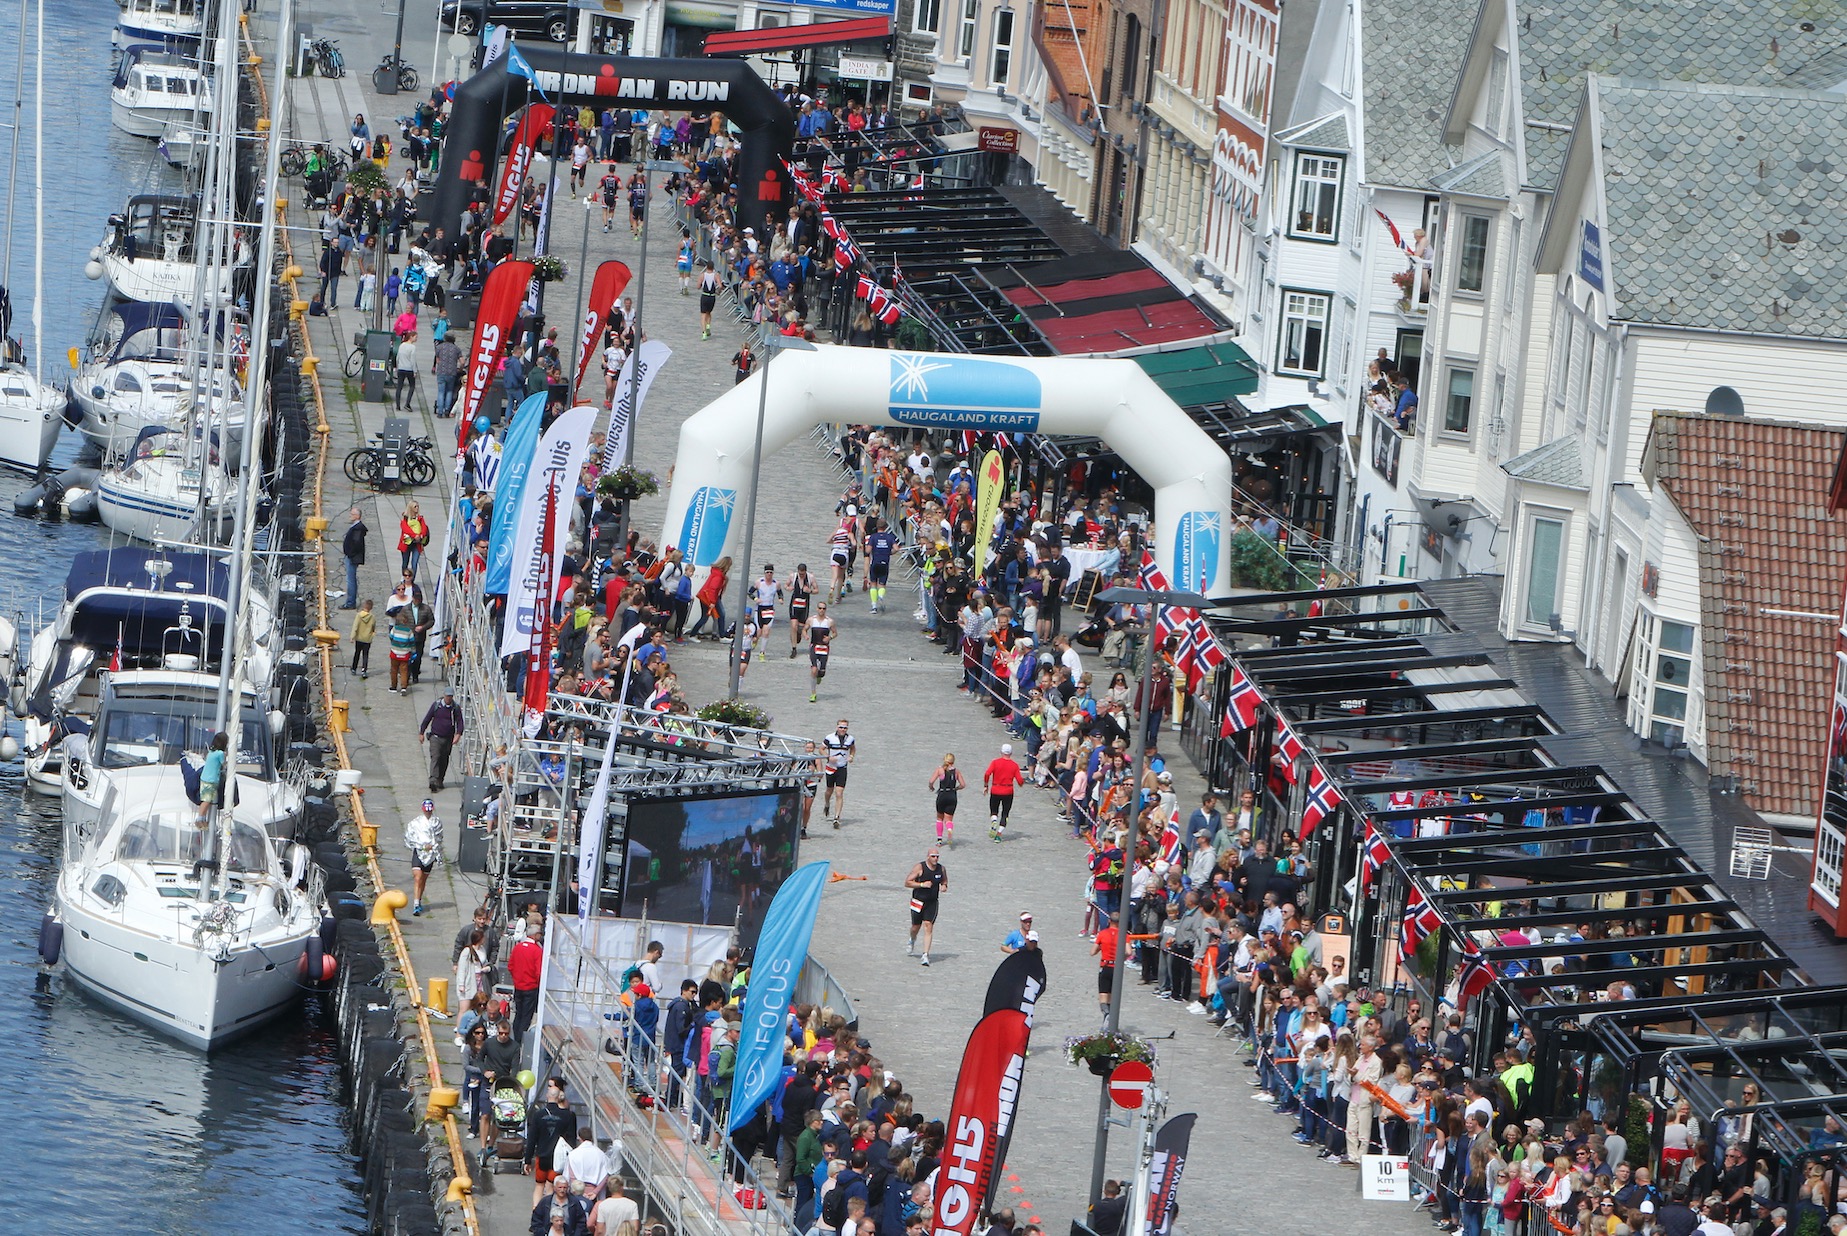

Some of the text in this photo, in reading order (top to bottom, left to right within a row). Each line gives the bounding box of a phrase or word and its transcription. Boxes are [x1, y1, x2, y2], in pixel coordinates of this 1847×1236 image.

[856, 0, 890, 10] redskaper
[533, 64, 729, 101] IRONMAN RUN
[848, 61, 870, 69] INDIA
[848, 67, 869, 75] GATE
[466, 322, 500, 421] HIGH5
[899, 410, 1034, 425] HAUGALAND KRAFT
[685, 491, 706, 562] HAUGALAND KRAFT
[1182, 517, 1190, 590] HAUGALAND KRAFT
[754, 958, 791, 1051] IFOCUS
[996, 974, 1041, 1137] IRONAN
[973, 1120, 998, 1214] NUTRITION
[1155, 1153, 1177, 1225] HAUGESUND
[1165, 1156, 1185, 1210] NORWAY
[1377, 1176, 1394, 1184] km
[1378, 1161, 1392, 1175] 10
